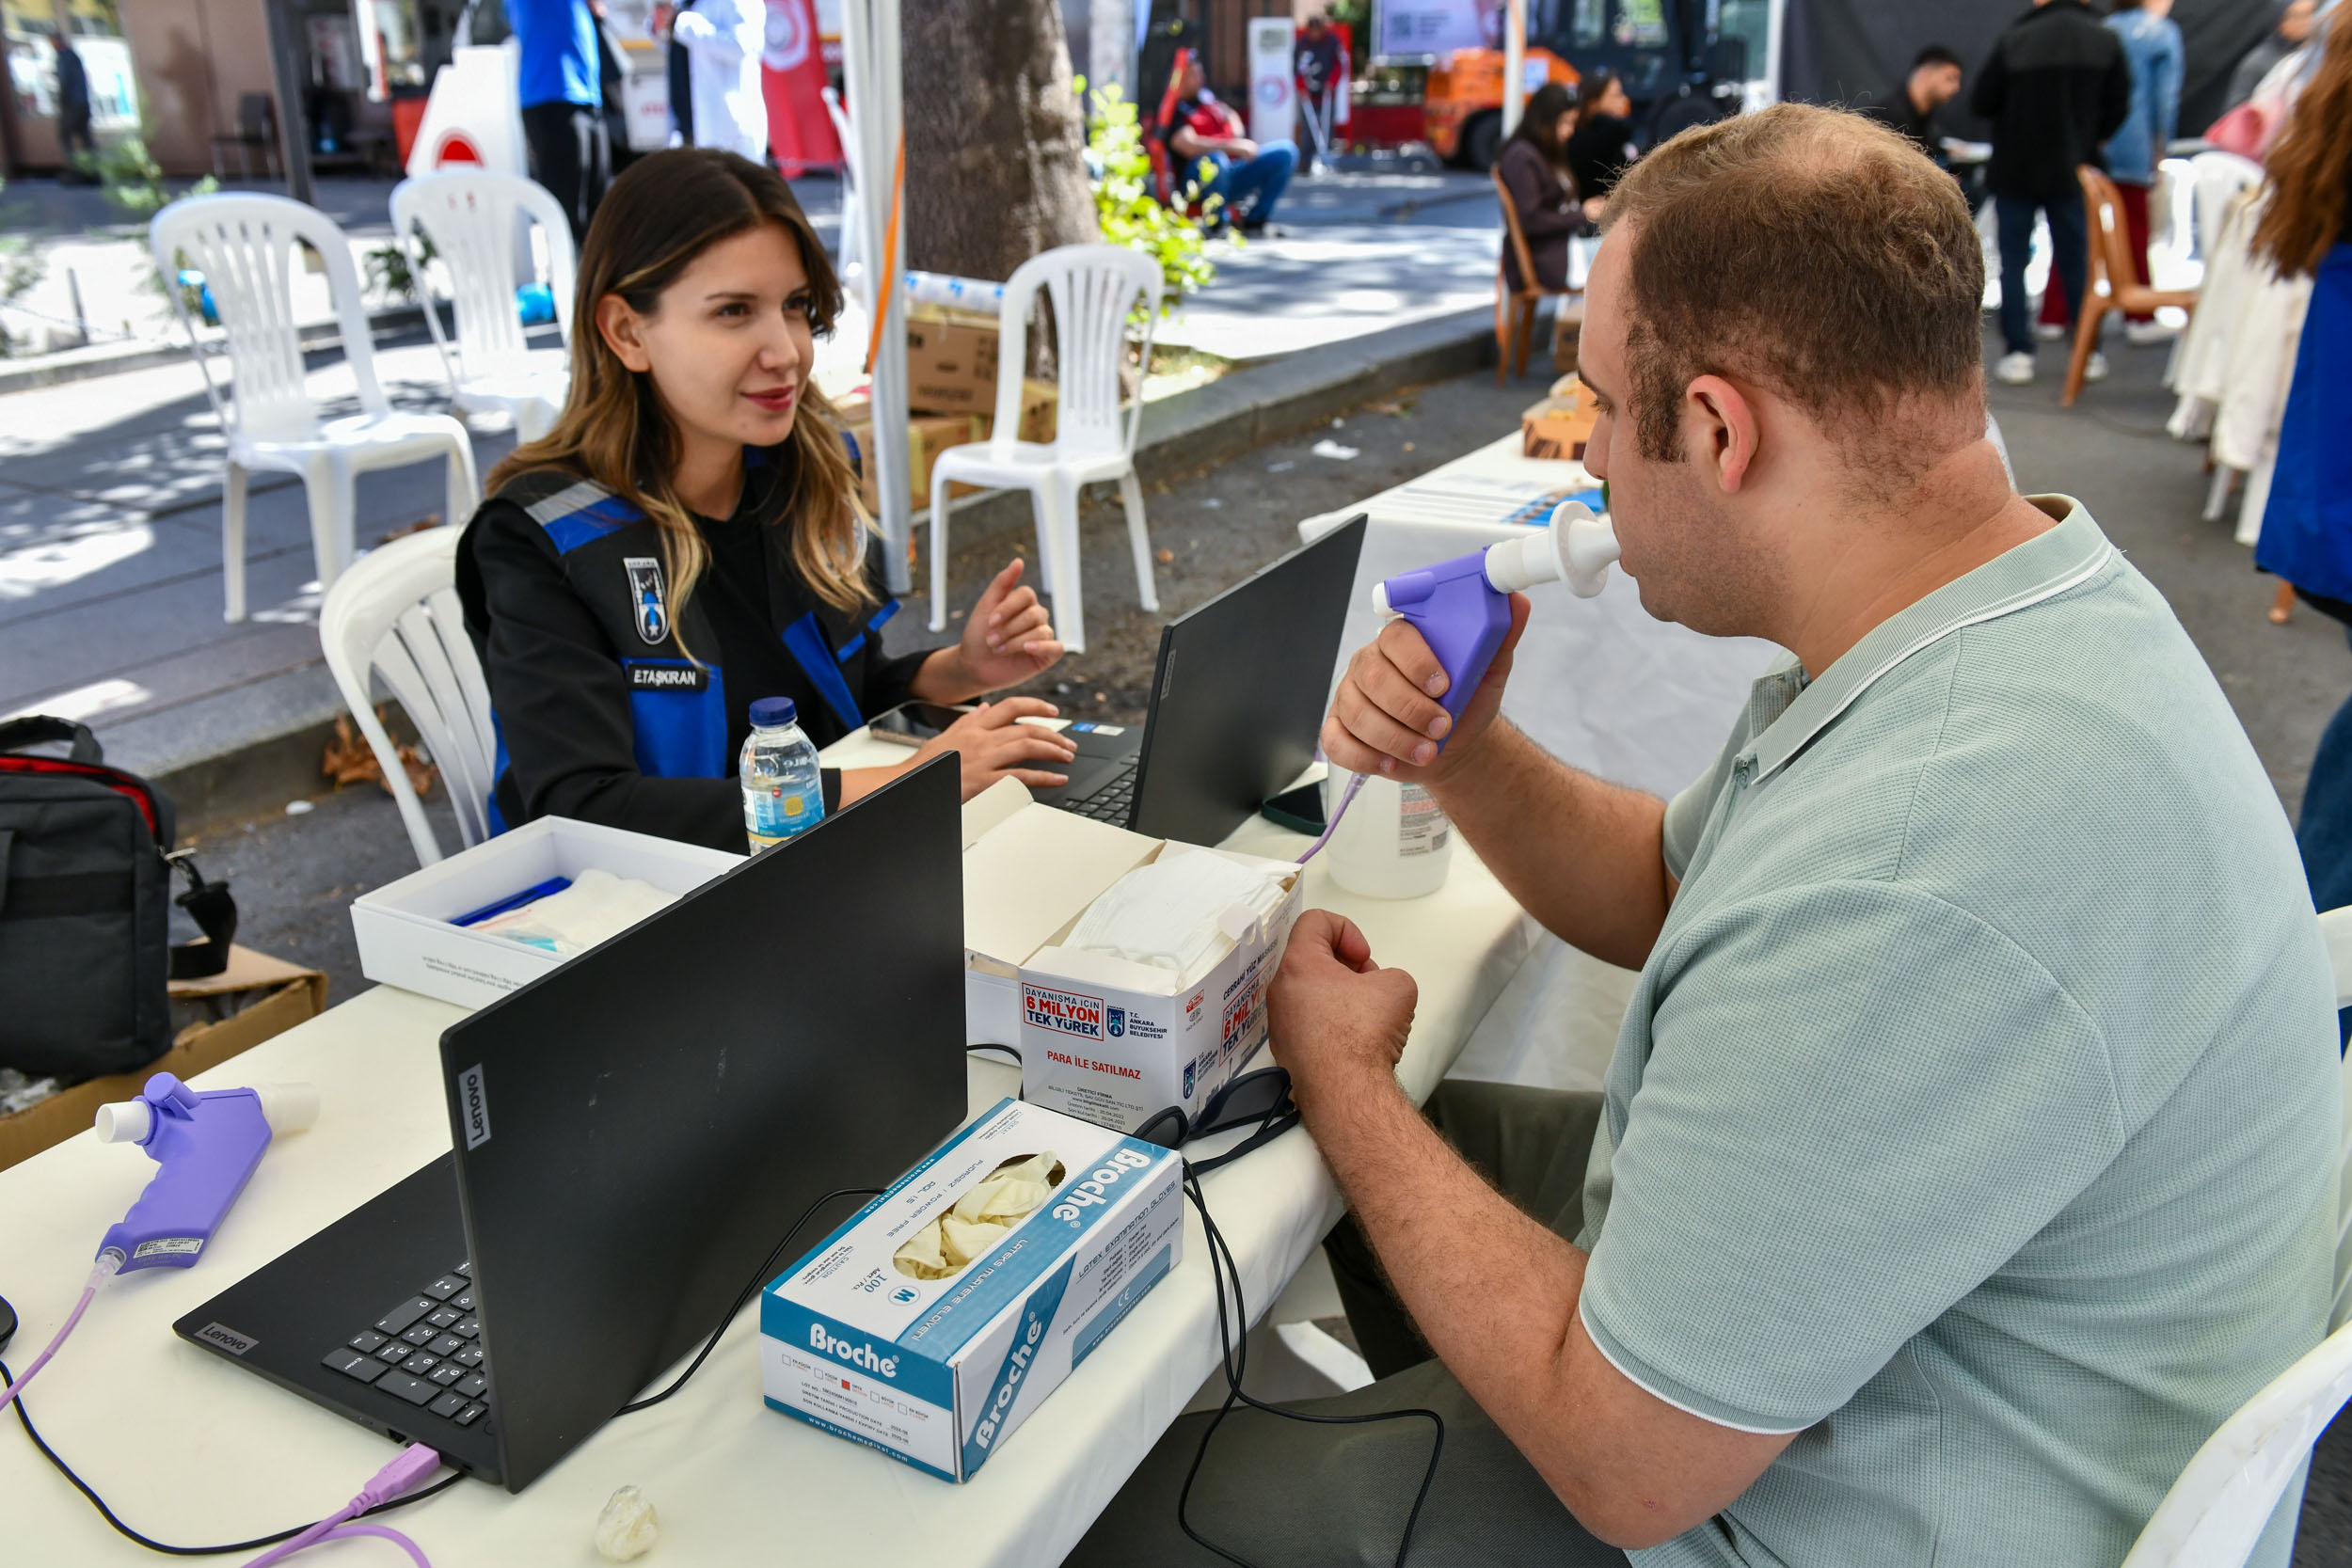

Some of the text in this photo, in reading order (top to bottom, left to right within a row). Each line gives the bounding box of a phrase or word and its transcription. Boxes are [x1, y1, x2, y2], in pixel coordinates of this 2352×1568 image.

[1026, 995, 1036, 1009] 6
[1027, 1009, 1100, 1037] TEK YÜREK
[1129, 1018, 1155, 1026] ANKARA
[1223, 1031, 1239, 1056] TEK
[1047, 1050, 1141, 1080] PARA İLE SATILMAZ
[468, 1074, 485, 1142] Lenovo
[1050, 1148, 1150, 1226] Broche
[910, 1193, 942, 1218] POWDER
[886, 1219, 909, 1237] FREE
[1078, 1251, 1102, 1277] LATEX
[1104, 1207, 1148, 1252] EXAMINATION
[1150, 1180, 1175, 1209] GLOVES
[821, 1257, 849, 1278] CAUTION
[864, 1274, 887, 1292] 100
[893, 1288, 914, 1302] M
[202, 1325, 247, 1350] Lenovo
[809, 1323, 896, 1377] Broche
[343, 1357, 363, 1370] Enter
[976, 1320, 1042, 1450] Broche
[808, 1417, 907, 1461] www.brochemedikal.com
